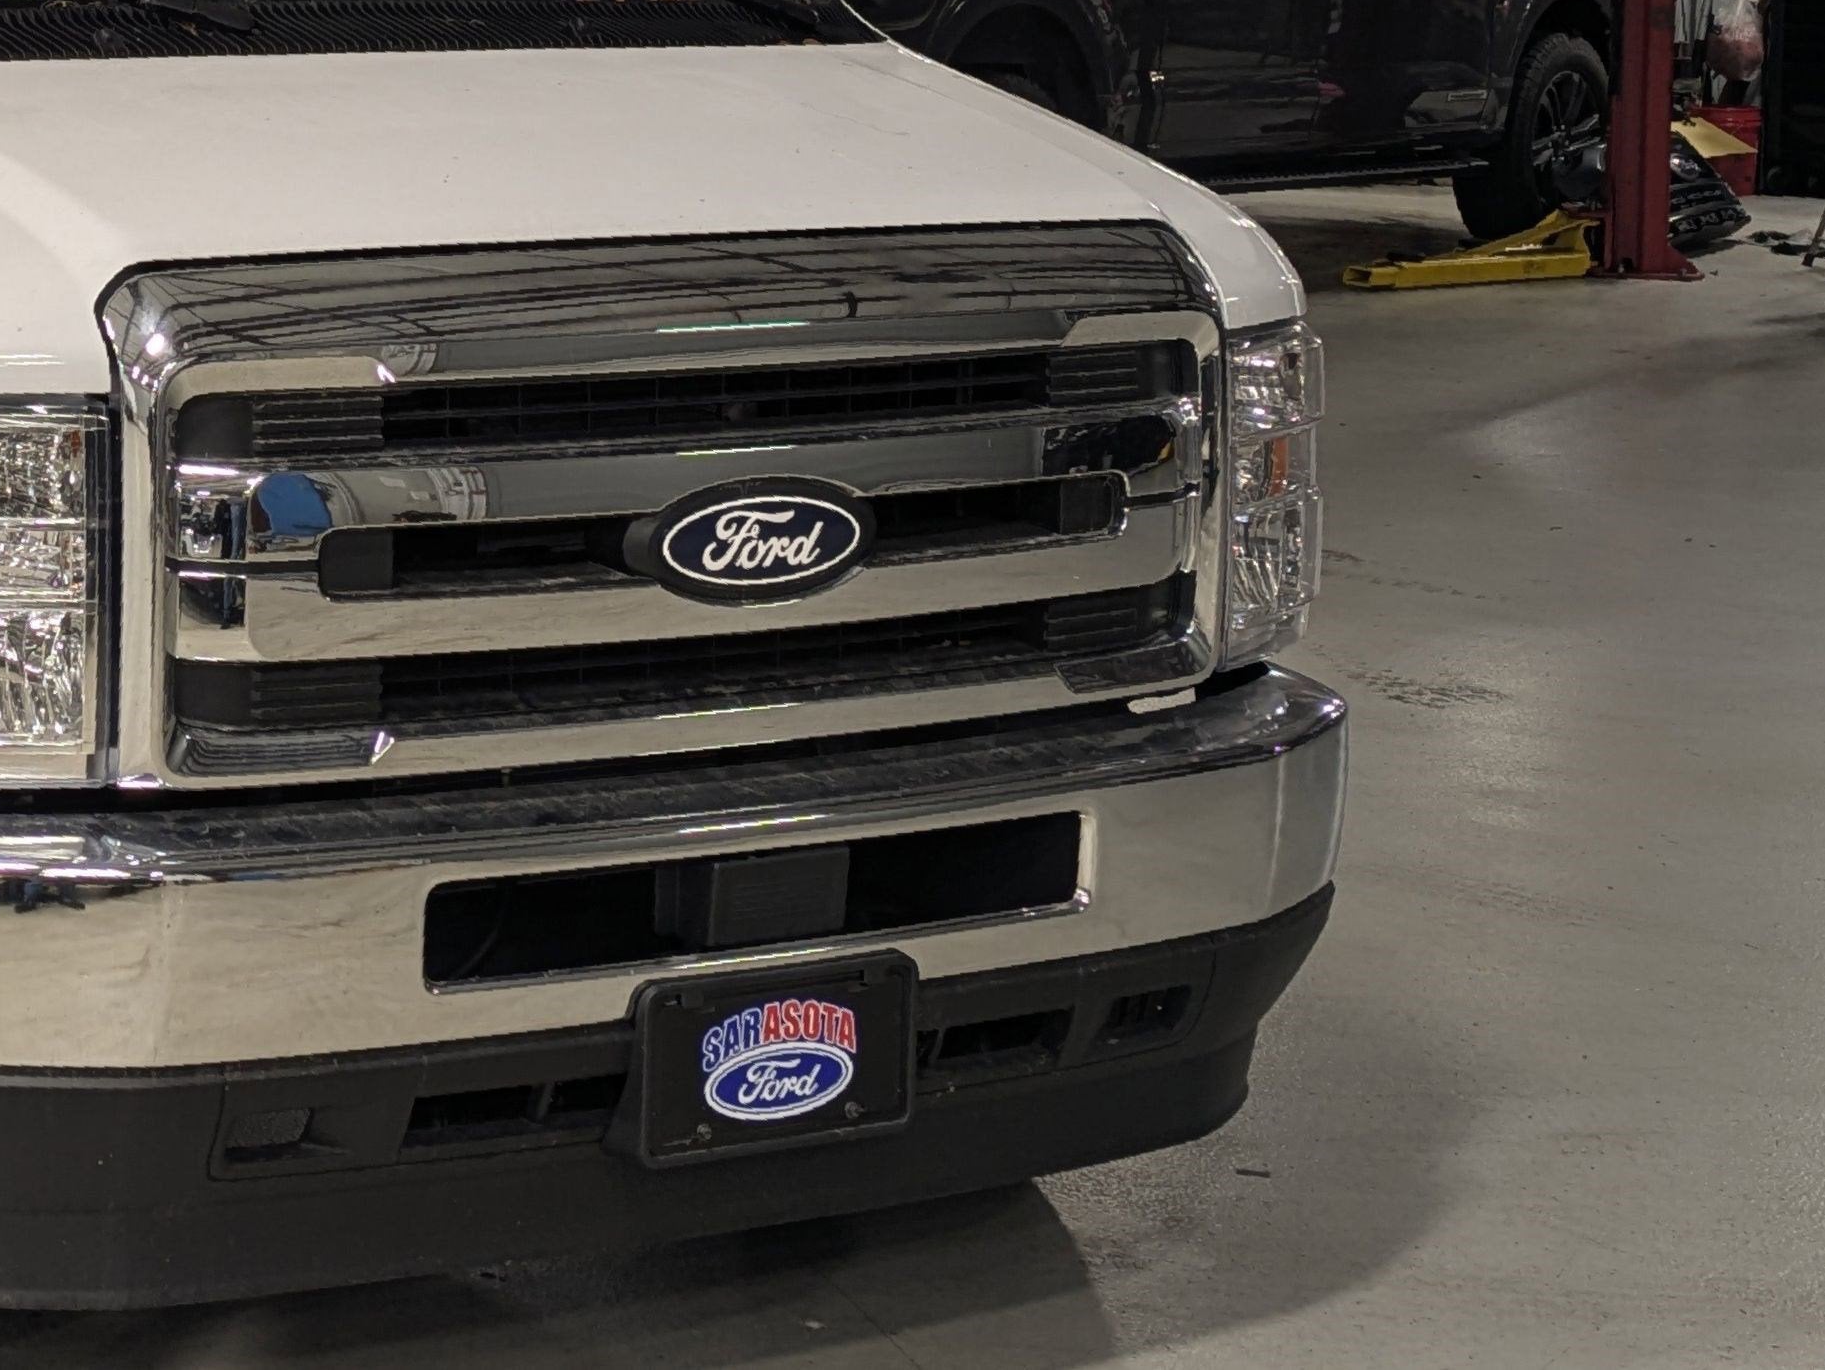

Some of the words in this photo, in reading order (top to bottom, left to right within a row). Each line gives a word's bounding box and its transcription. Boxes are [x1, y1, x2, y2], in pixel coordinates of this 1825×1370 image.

[702, 509, 825, 572] Ford
[702, 998, 857, 1072] SARASOTA
[738, 1058, 821, 1105] Ford
